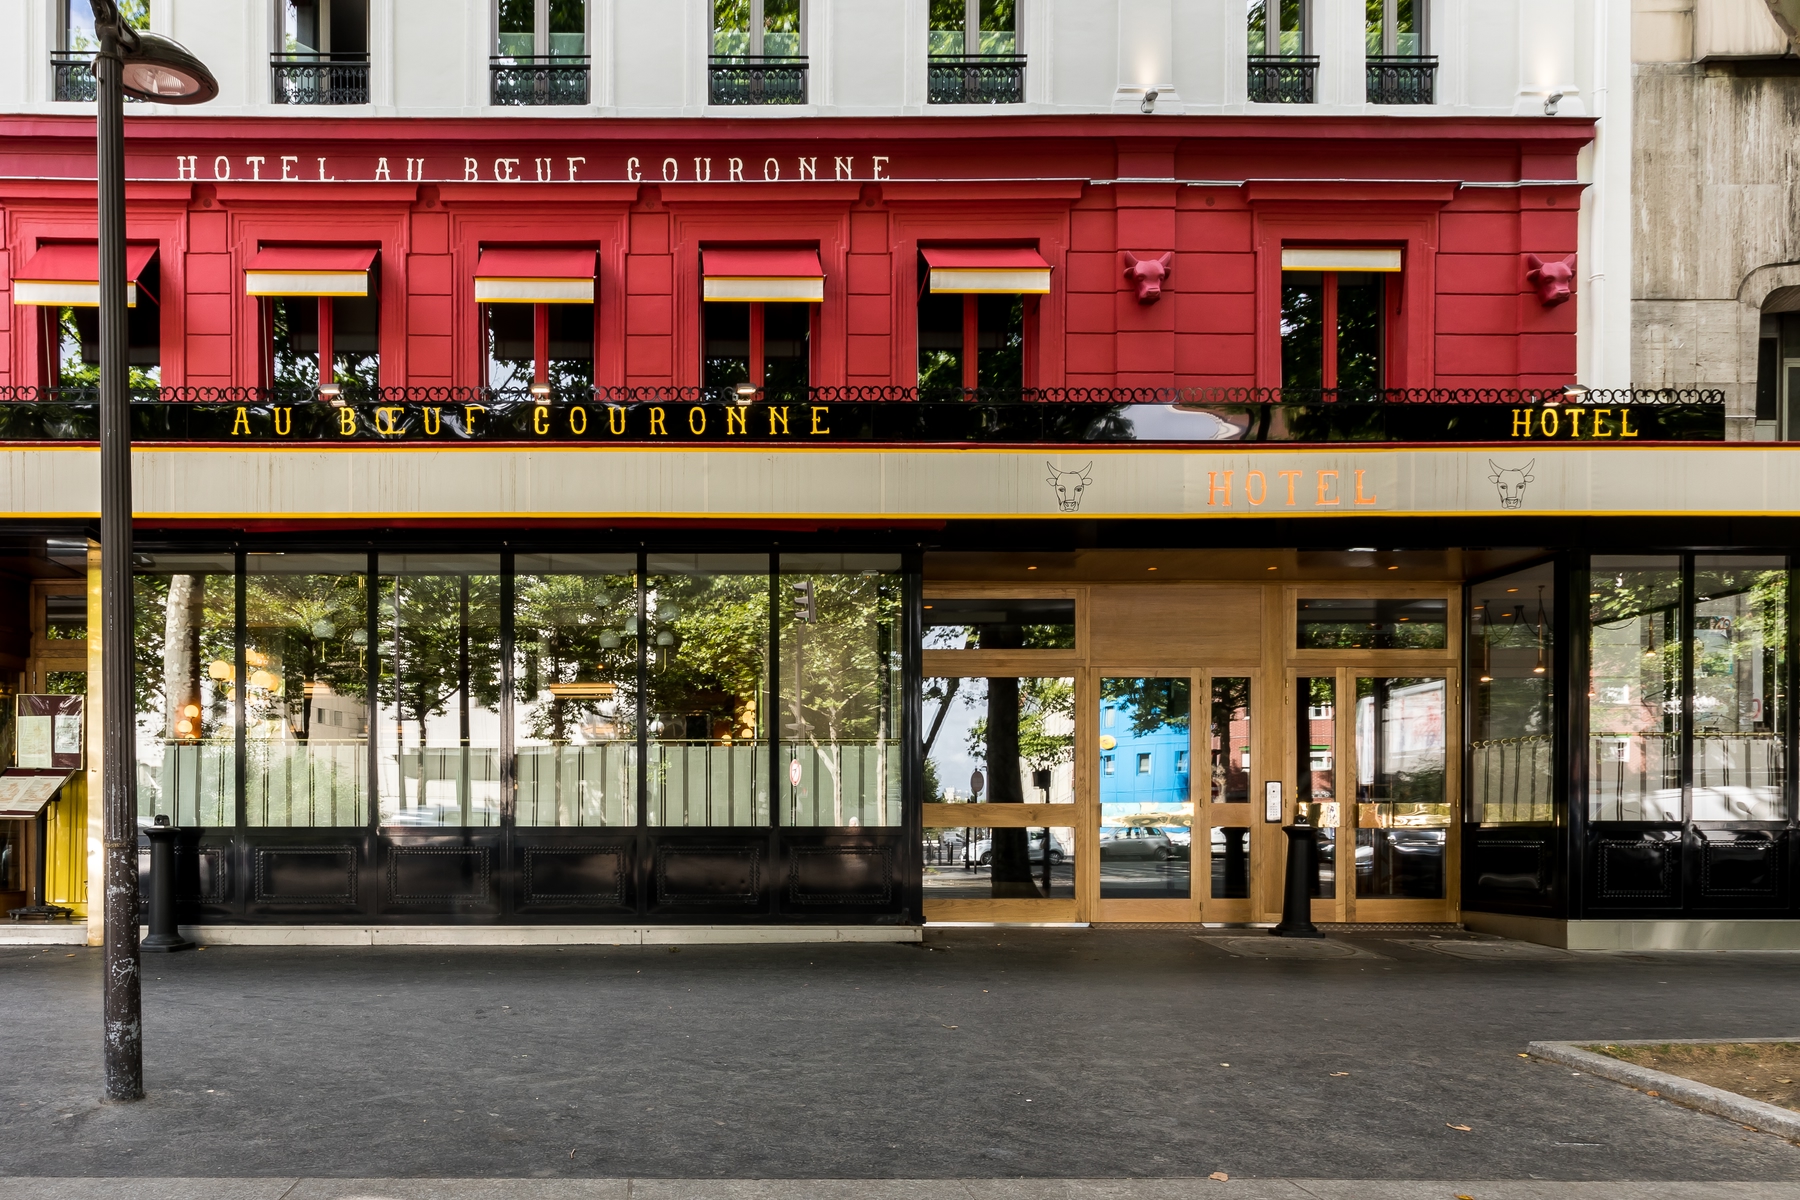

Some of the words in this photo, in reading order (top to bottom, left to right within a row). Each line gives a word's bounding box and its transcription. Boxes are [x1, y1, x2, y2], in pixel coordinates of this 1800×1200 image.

[176, 155, 335, 181] HOTEL
[375, 157, 425, 181] AU
[231, 406, 291, 436] AU
[1511, 407, 1639, 437] HOTEL
[1207, 469, 1378, 507] HOTEL
